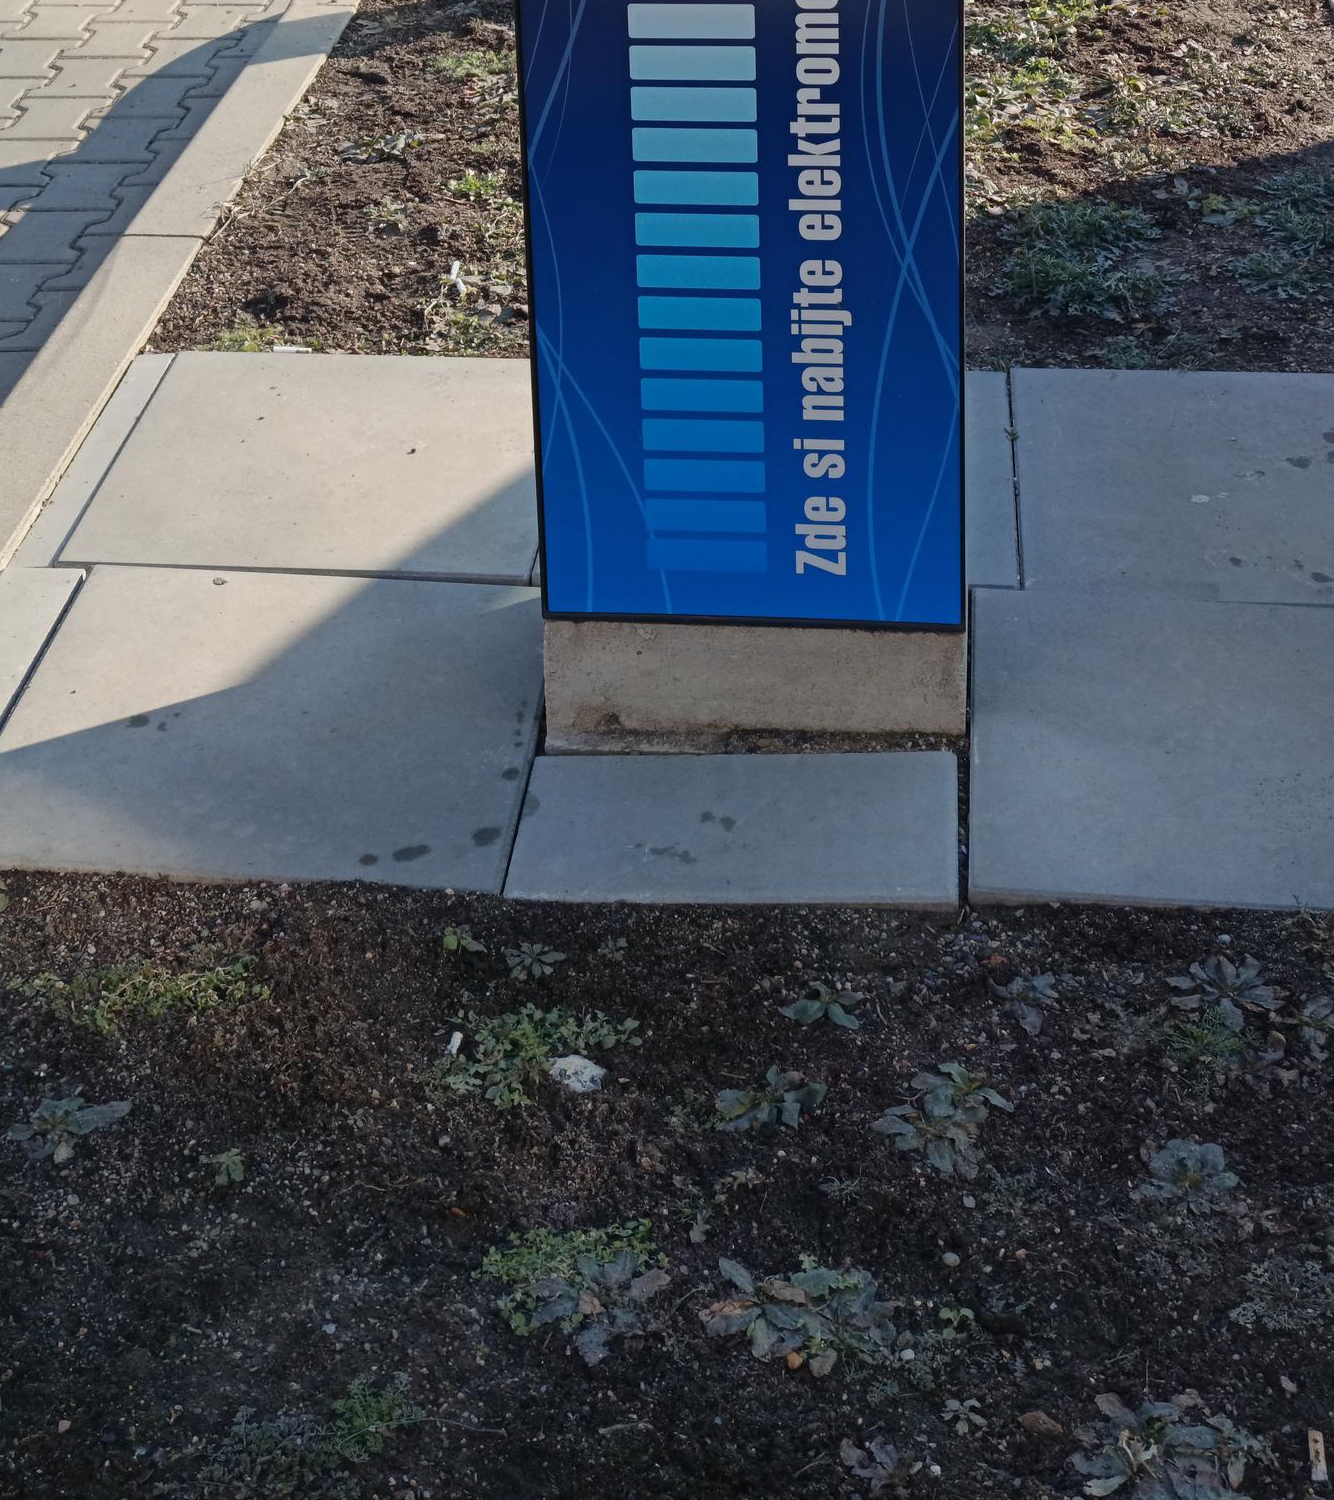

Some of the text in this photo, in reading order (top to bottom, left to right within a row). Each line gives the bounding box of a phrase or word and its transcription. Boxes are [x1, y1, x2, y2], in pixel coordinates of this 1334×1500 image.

[791, 259, 852, 421] nabijte
[794, 438, 846, 479] si
[795, 496, 846, 576] Zde
